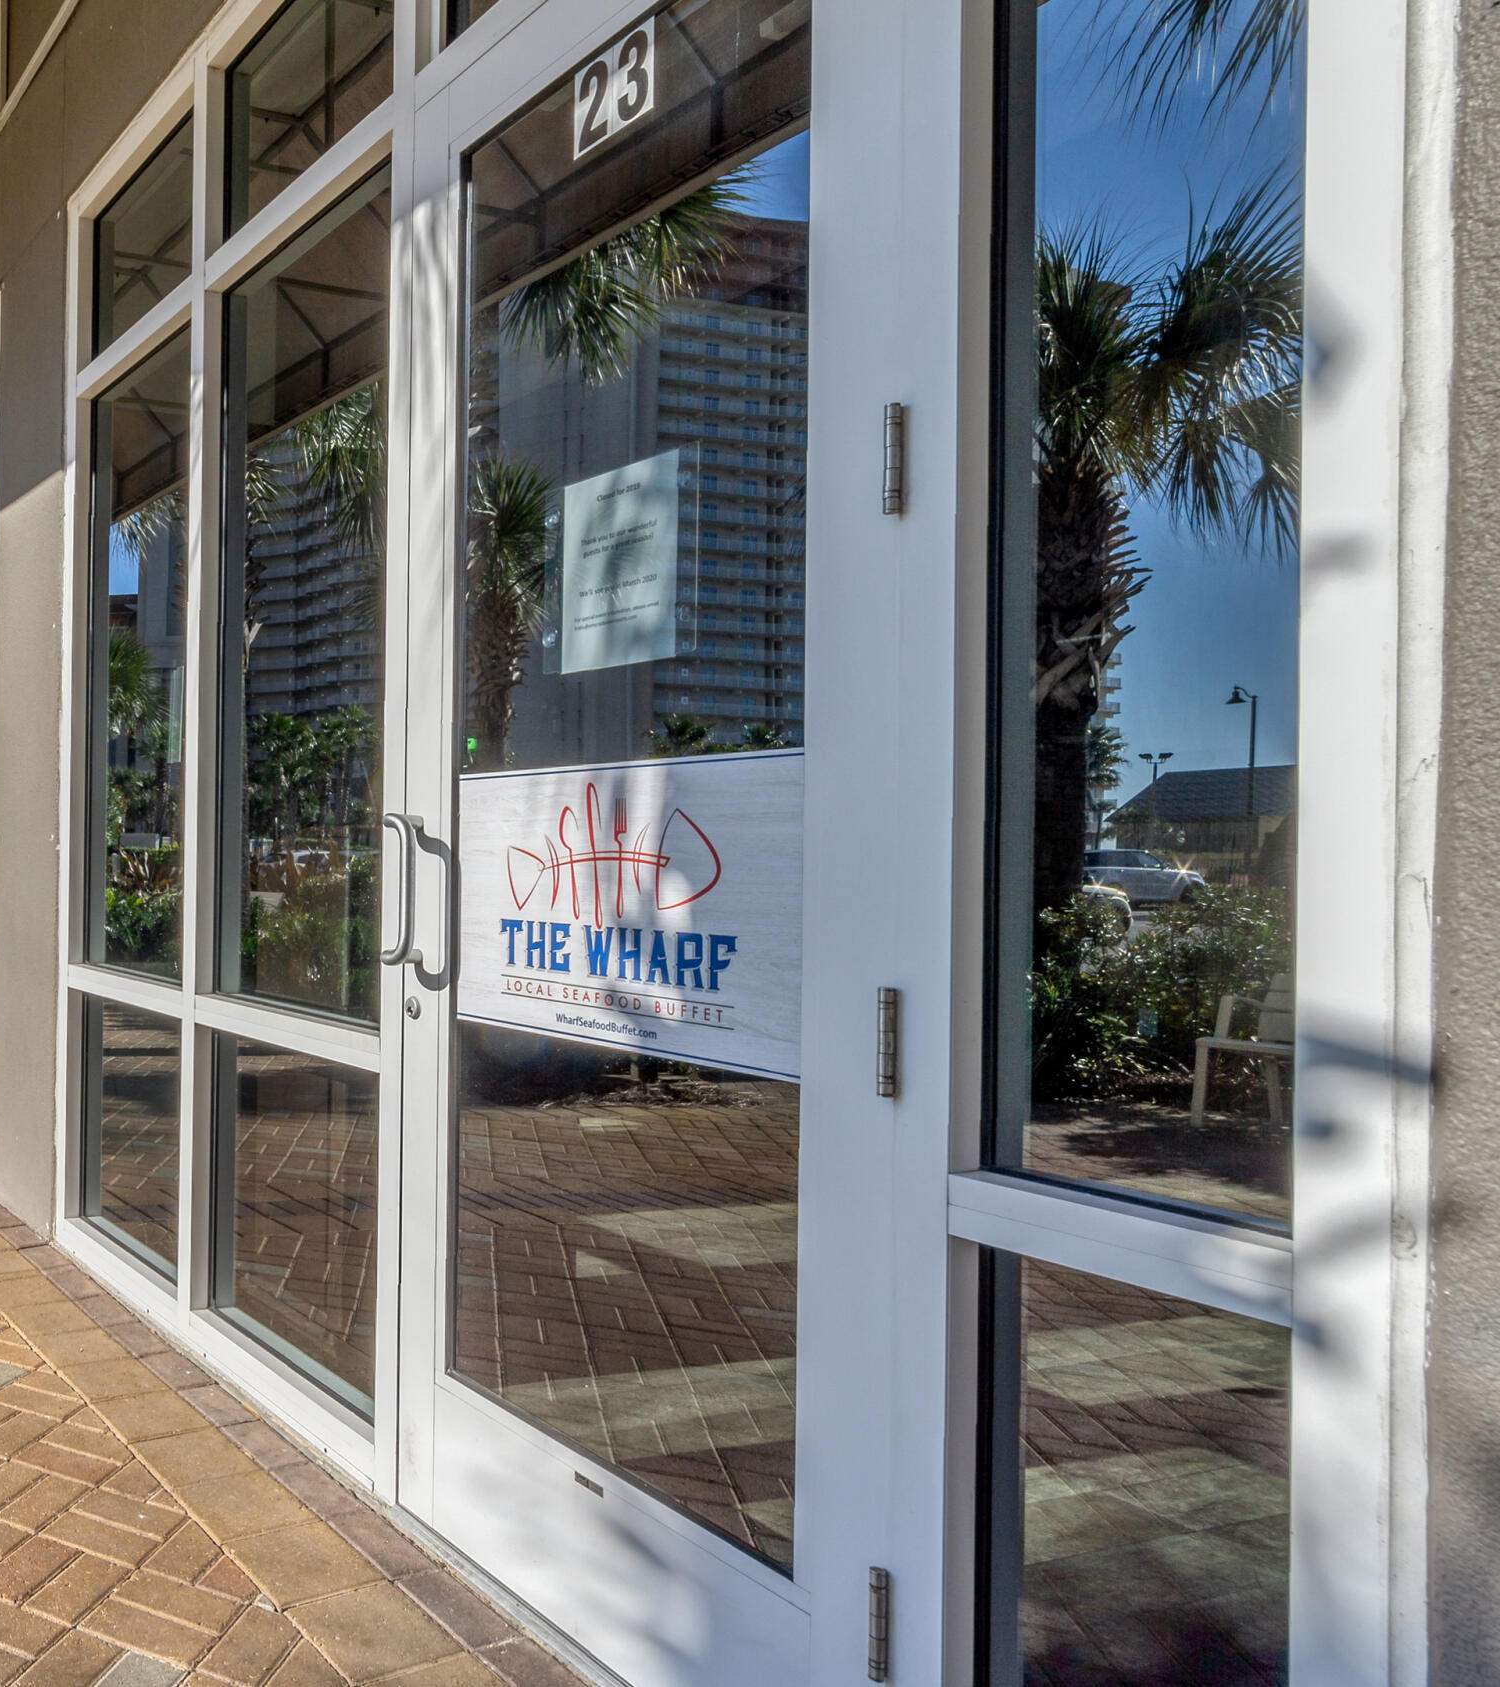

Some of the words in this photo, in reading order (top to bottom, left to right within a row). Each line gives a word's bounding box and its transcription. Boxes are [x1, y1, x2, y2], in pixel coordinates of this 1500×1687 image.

[578, 30, 648, 153] 23
[597, 490, 615, 502] Closed
[616, 487, 625, 496] for
[581, 536, 596, 546] Thank
[597, 534, 607, 543] you
[627, 519, 657, 533] wonderful
[583, 547, 600, 559] guests
[601, 545, 609, 553] for
[580, 588, 593, 597] We'll
[595, 586, 604, 594] see
[622, 578, 641, 587] March
[642, 573, 657, 583] 2020
[500, 918, 571, 973] THE
[583, 925, 738, 991] WHARF
[506, 979, 552, 997] LOCAL
[563, 987, 641, 1010] SEAFOOD
[655, 1001, 724, 1023] BUFFET
[556, 1013, 657, 1040] WharfSeafoodBuffet.com
